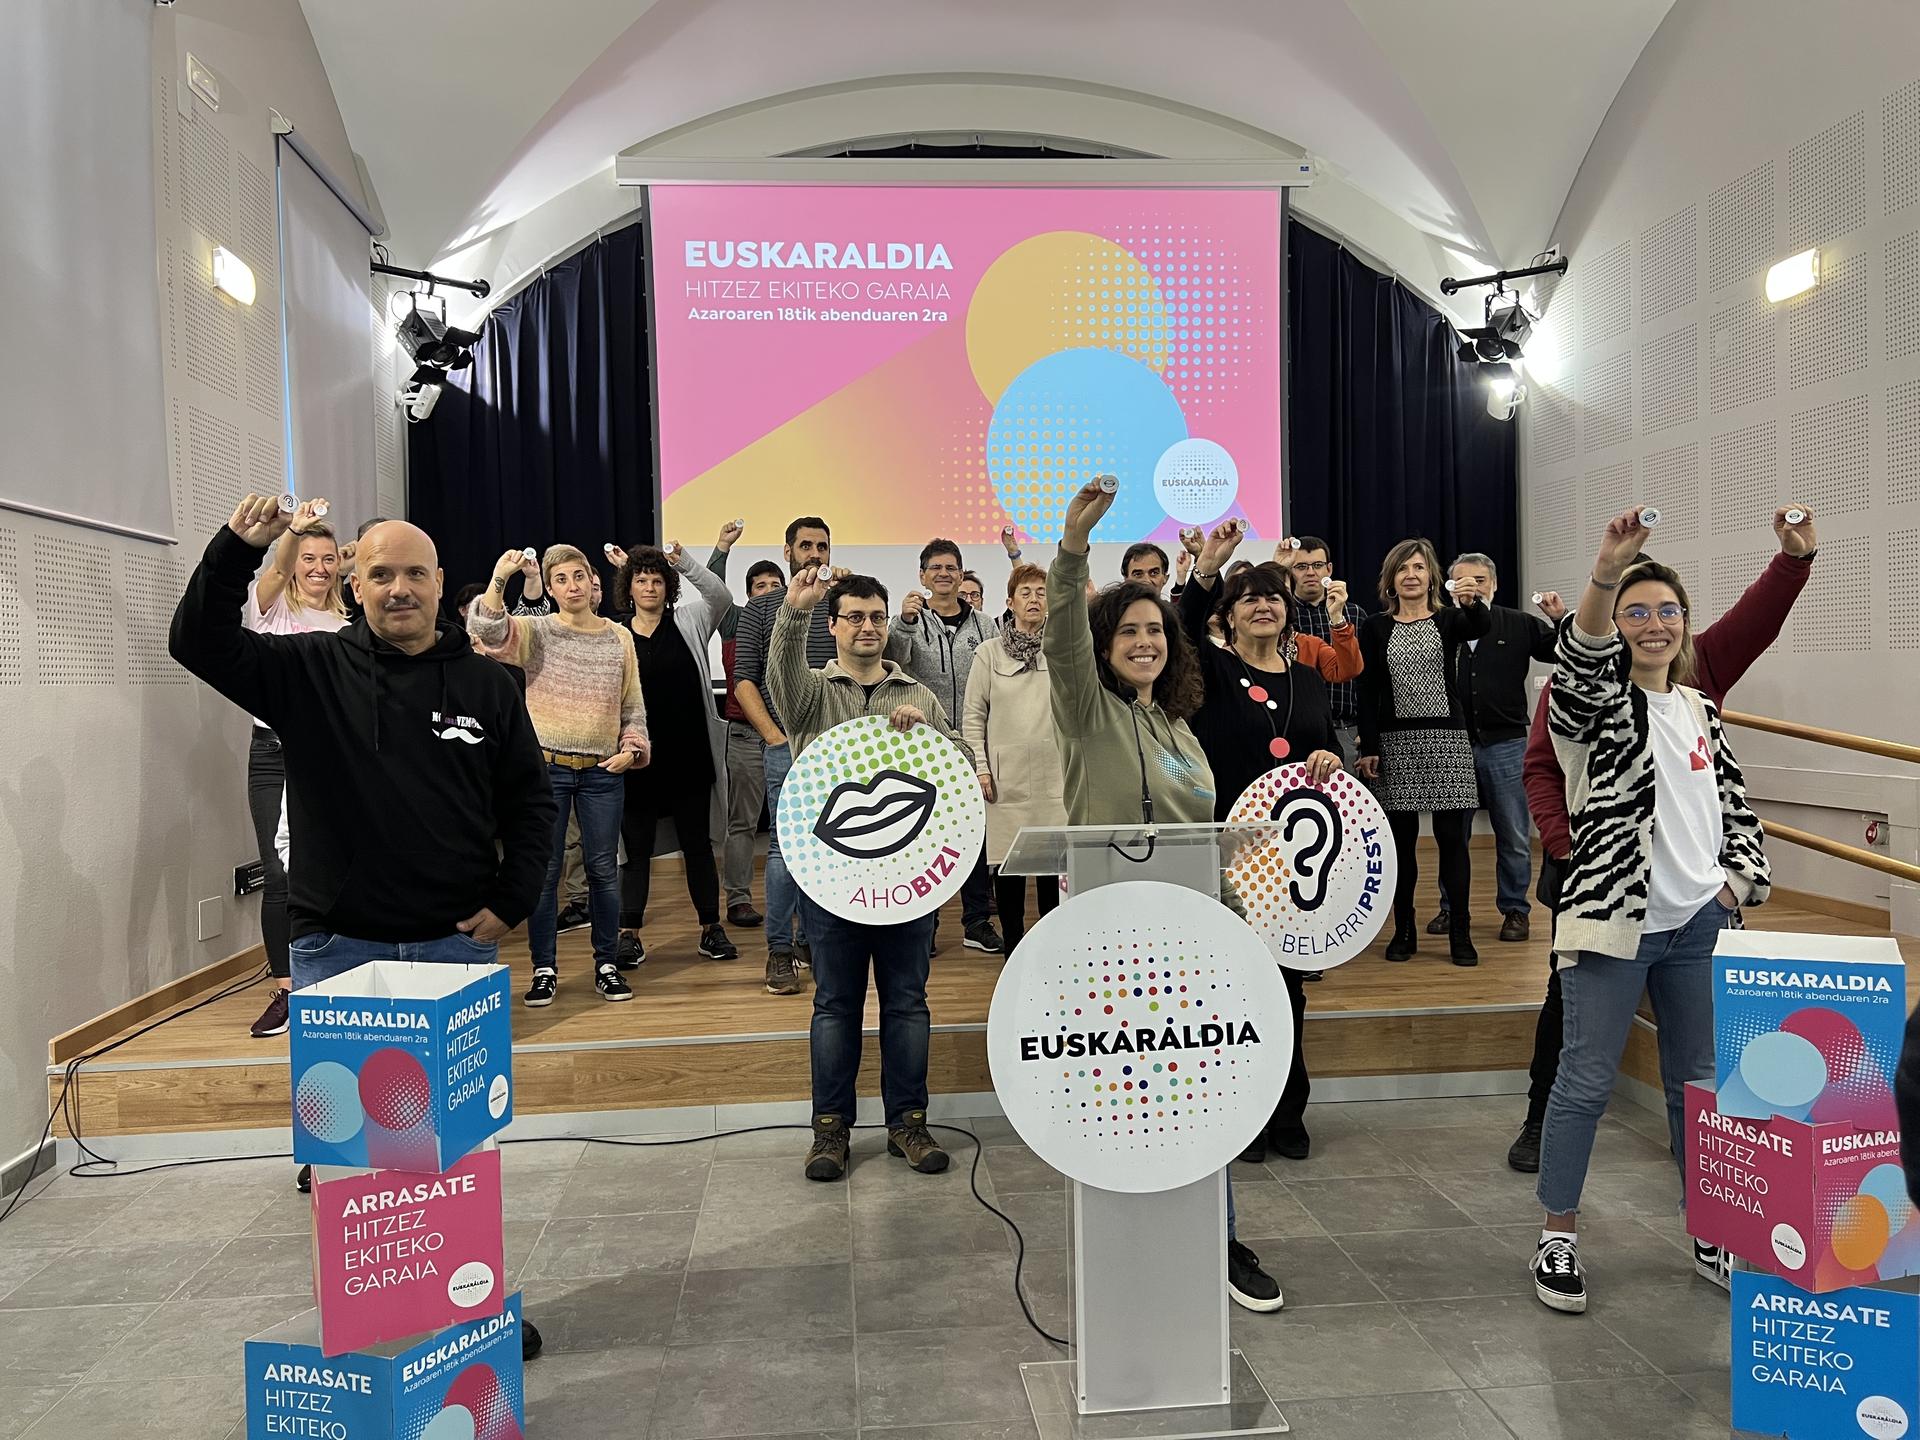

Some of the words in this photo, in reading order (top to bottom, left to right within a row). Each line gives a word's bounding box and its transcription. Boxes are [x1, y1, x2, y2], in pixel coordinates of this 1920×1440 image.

[685, 240, 953, 270] EUSKARALDIA
[686, 281, 761, 299] HITZEZ
[769, 281, 859, 300] EKITEKO
[867, 282, 951, 300] GARAIA
[688, 308, 774, 320] Azaroaren
[777, 307, 817, 321] 18tik
[822, 308, 919, 322] abenduaren
[922, 309, 948, 322] 2ra
[1162, 479, 1229, 487] EUSKARALDIA
[849, 846, 960, 908] AHOBIZI
[1282, 827, 1382, 955] BELARRIPREST
[1725, 969, 1892, 992] EUSKARALDIA
[1726, 987, 1778, 998] Azaroaren
[1780, 989, 1803, 999] 18tik
[1806, 991, 1870, 1003] abenduaren
[1872, 995, 1889, 1004] 2ra
[301, 1009, 430, 1029] EUSKARALDIA
[446, 991, 501, 1035] ARRASATE
[302, 1031, 342, 1040] Azaroaren
[344, 1032, 362, 1040] 18tik
[363, 1033, 413, 1043] abenduaren
[415, 1035, 428, 1043] 2ra
[446, 1026, 480, 1060] HITZEZ
[1020, 1021, 1261, 1061] EUSKARALDIA
[447, 1048, 488, 1086] EKITEKO
[448, 1074, 485, 1111] GARAIA
[1697, 1109, 1793, 1158] ARRASATE
[1699, 1131, 1756, 1167] HITZEZ
[1699, 1154, 1769, 1195] EKITEKO
[1823, 1155, 1859, 1166] Azaroaren
[1876, 1148, 1899, 1158] abend
[342, 1174, 476, 1218] ARRASATE
[1699, 1178, 1765, 1219] GARAIA
[344, 1209, 426, 1244] HITZEZ
[345, 1232, 444, 1270] EKITEKO
[345, 1260, 438, 1296] GARAIA
[1751, 1293, 1891, 1328] ARRASATE
[403, 1310, 515, 1382] EUSKARALDIA
[1752, 1316, 1836, 1344] HITZEZ
[404, 1369, 442, 1395] Azaroaren
[460, 1335, 502, 1362] abenduaren
[1752, 1341, 1853, 1371] EKITEKO
[264, 1363, 372, 1394] ARRASATE
[1752, 1365, 1847, 1395] GARAIA
[266, 1388, 333, 1414] HITZEZ
[266, 1414, 346, 1440] EKITEKO
